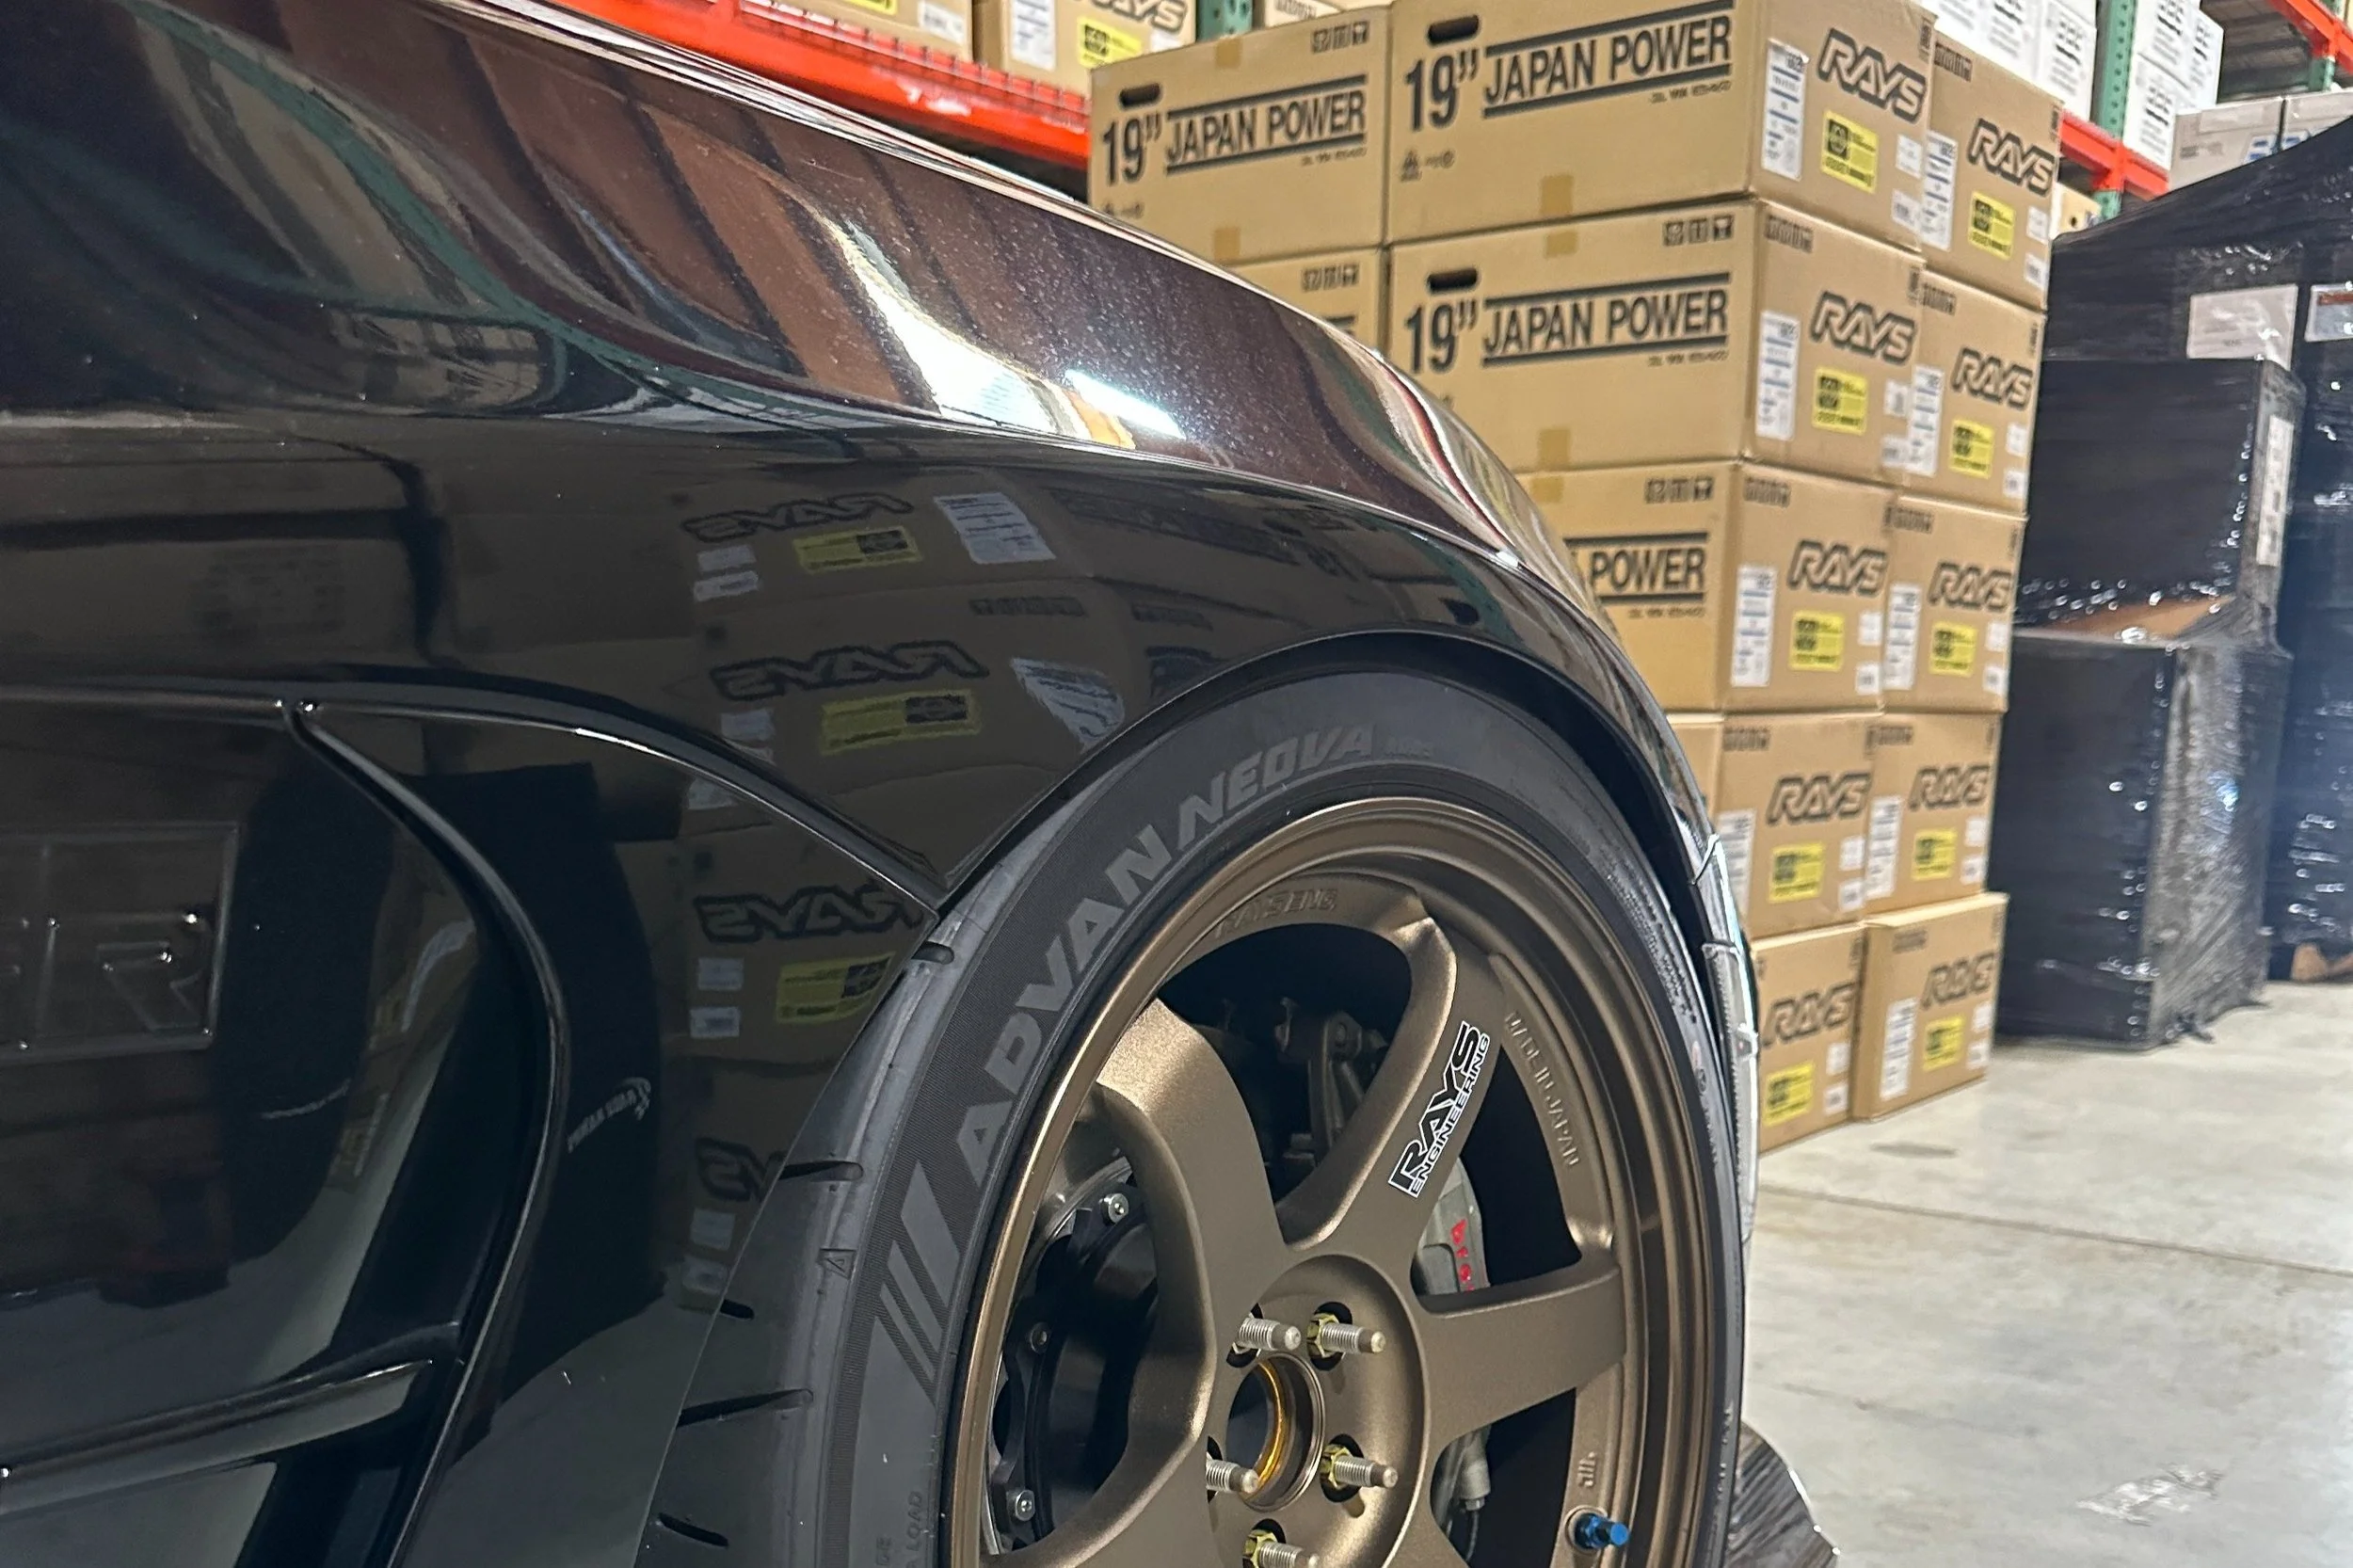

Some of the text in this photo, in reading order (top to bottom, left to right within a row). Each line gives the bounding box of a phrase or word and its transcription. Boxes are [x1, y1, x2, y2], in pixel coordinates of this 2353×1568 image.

[1483, 39, 1597, 104] JAPAN
[1609, 15, 1730, 80] POWER
[1817, 28, 1927, 124] RAYS
[1166, 107, 1257, 163] JAPAN
[1267, 89, 1365, 144] POWER
[1967, 118, 2055, 197] RAYS
[1482, 299, 1595, 355] JAPAN
[1607, 289, 1727, 343] POWER
[1809, 290, 1915, 366] RAYS
[1950, 347, 2033, 410] RAYS
[1589, 548, 1706, 592] POWER
[1787, 540, 1887, 597] RAYS
[1929, 562, 2012, 612] RAYS
[1766, 771, 1871, 825] RAYS
[1909, 764, 1990, 811] RAYS
[955, 723, 1374, 1179] ADVAN NEOVA
[1921, 952, 1996, 1009] RAYS
[1763, 981, 1856, 1048] RAYS
[1389, 1020, 1481, 1193] RAYS
[1411, 1033, 1490, 1198] ENGINEERING
